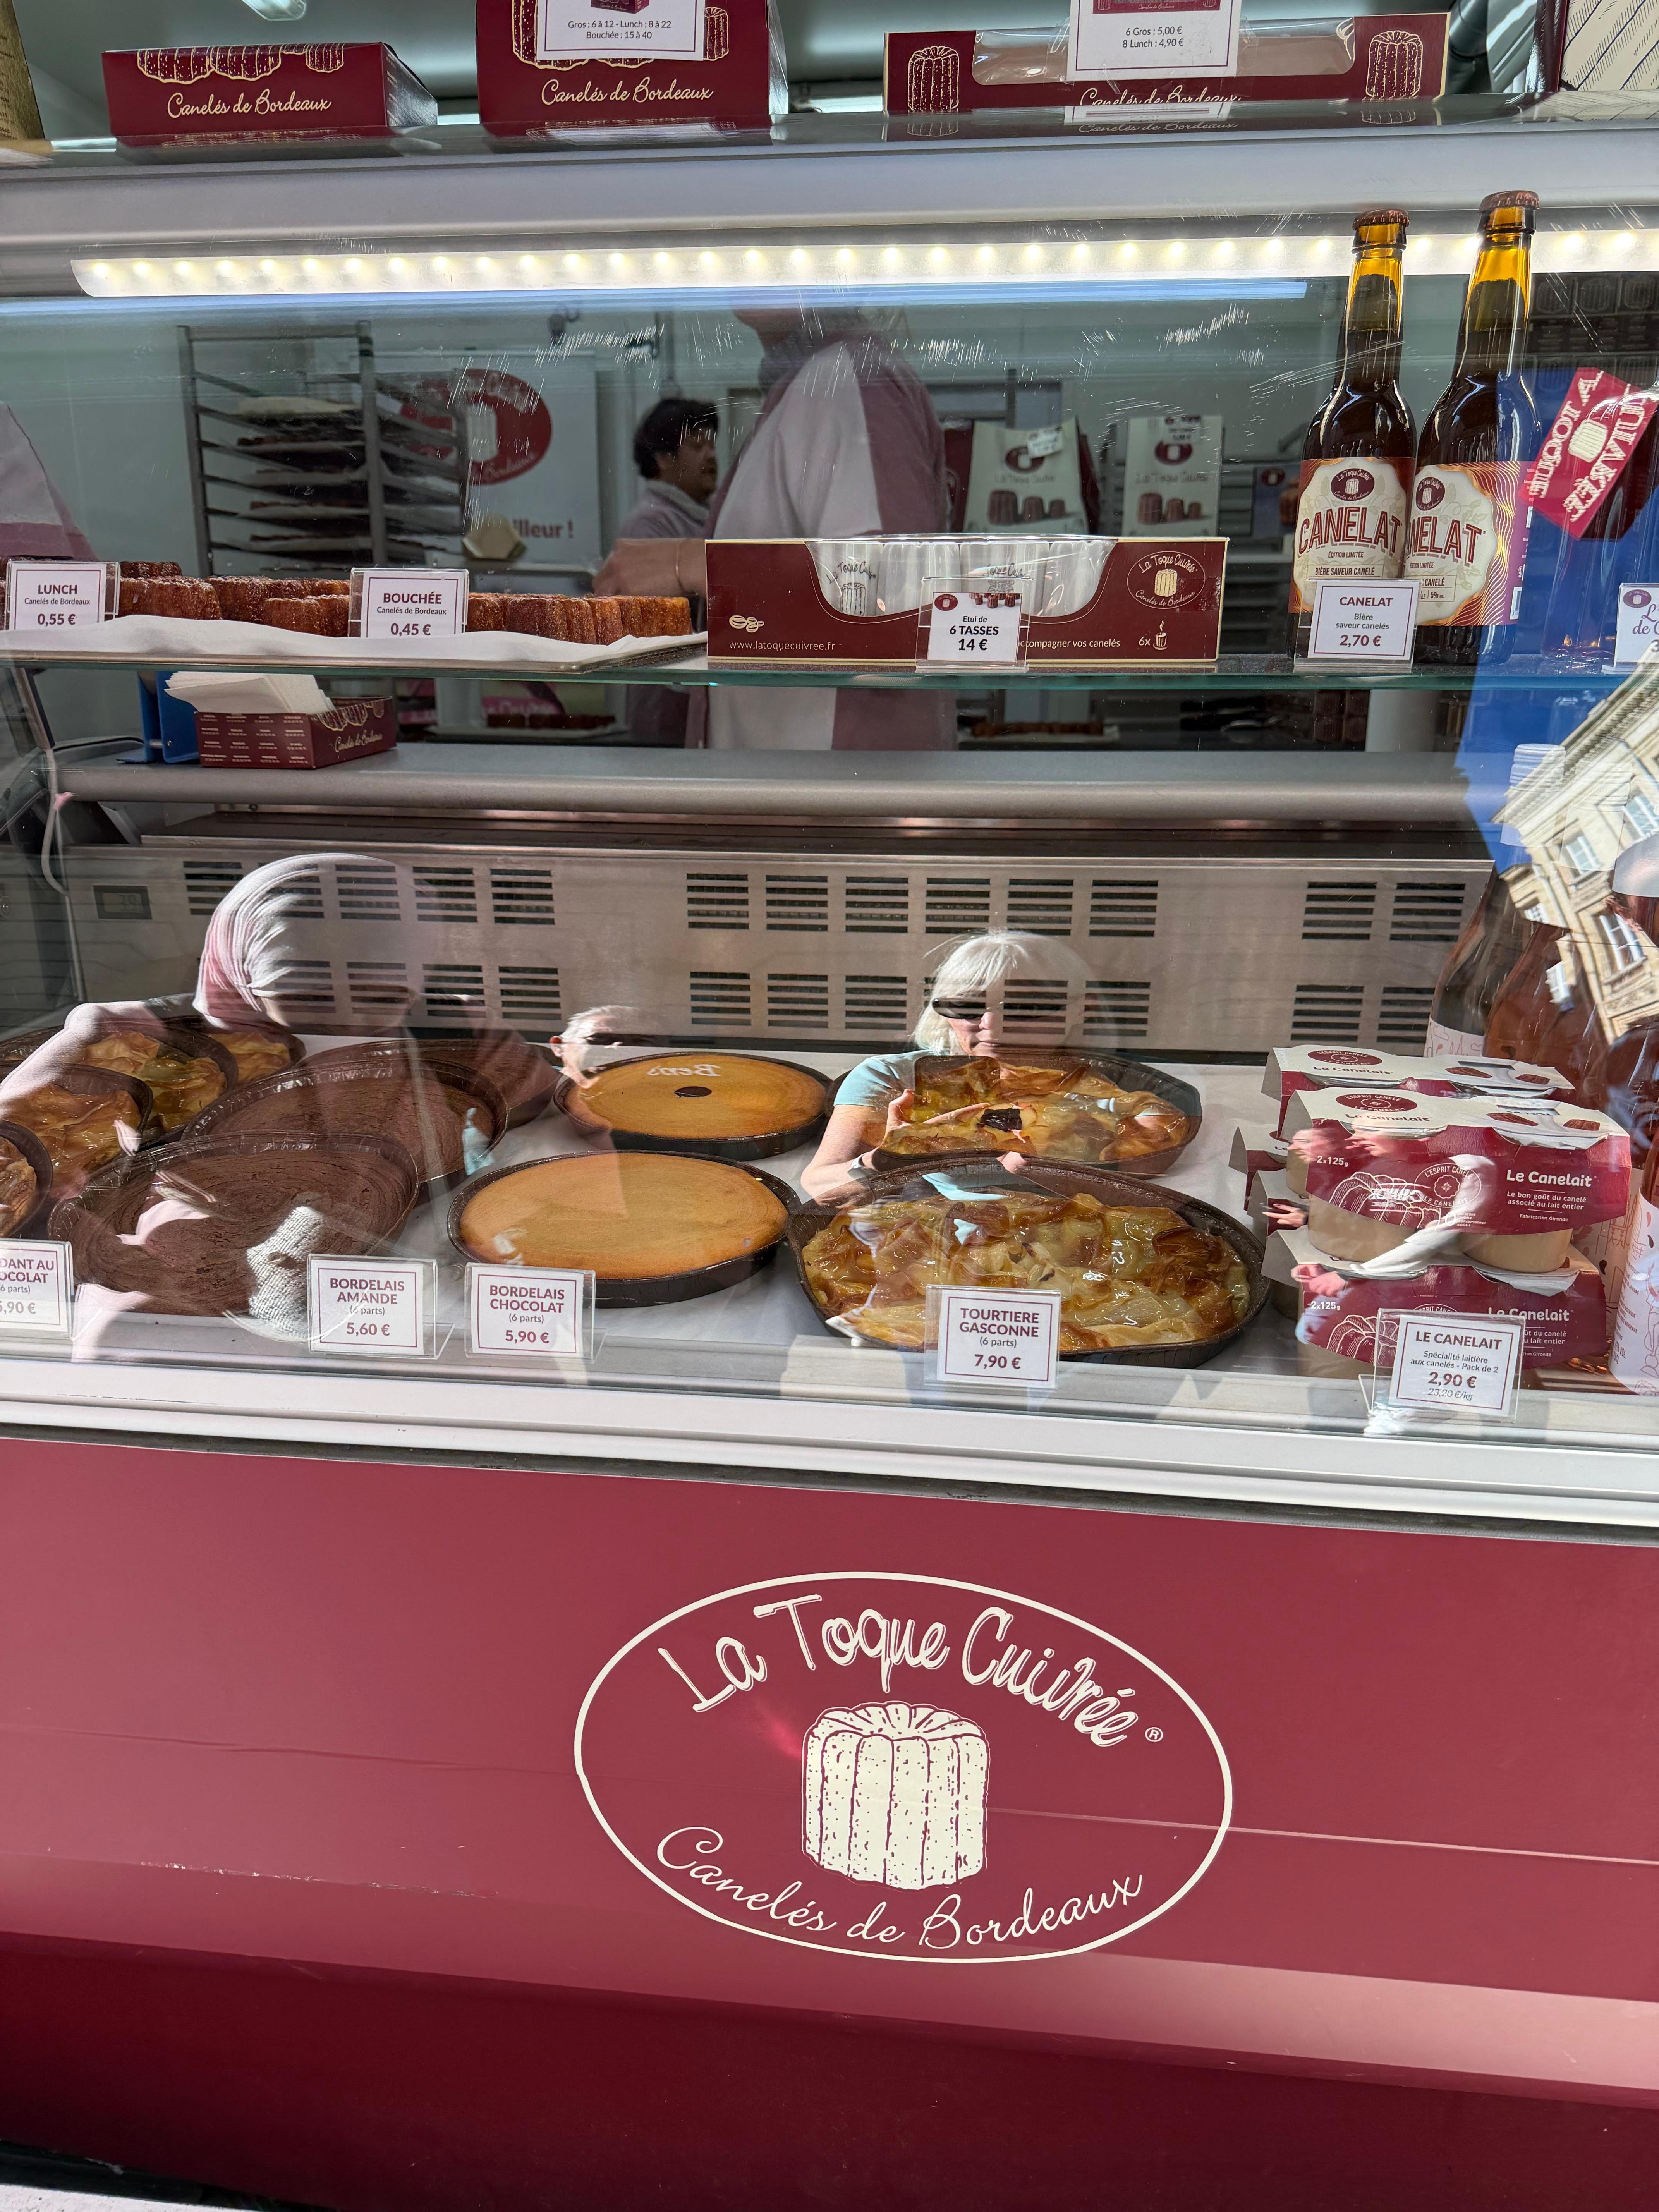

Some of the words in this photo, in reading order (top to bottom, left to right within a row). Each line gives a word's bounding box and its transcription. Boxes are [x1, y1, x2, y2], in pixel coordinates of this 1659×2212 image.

[1133, 27, 1151, 36] Gros
[1158, 27, 1175, 36] 5,00
[1177, 26, 1182, 34] €
[1130, 40, 1152, 48] Lunch
[1159, 38, 1176, 48] 4,90
[1178, 38, 1184, 46] €
[541, 79, 608, 105] Canelés
[609, 79, 630, 101] de
[632, 77, 714, 103] Bordeaux
[167, 92, 230, 118] Canelés
[233, 93, 252, 112] de
[254, 89, 331, 115] Bordeaux
[1298, 507, 1401, 554] CANELAT
[1408, 516, 1482, 563] NELAT
[1315, 566, 1329, 575] BIÈRE
[1331, 567, 1352, 575] SAVEUR
[1354, 567, 1374, 575] CANELÉ
[1425, 577, 1445, 586] CANELÉ
[38, 584, 77, 594] LUNCH
[383, 591, 442, 605] BOUCHÉE
[1340, 597, 1393, 607] CANELAT
[377, 606, 402, 614] Canelés
[415, 607, 447, 615] Bordeaux
[37, 613, 64, 627] 0,55
[68, 614, 76, 625] €
[390, 623, 419, 637] 0,45
[422, 624, 431, 635] €
[950, 626, 956, 634] 6
[959, 625, 999, 635] TASSES
[1632, 620, 1650, 634] de
[729, 641, 835, 651] www.latoquecuivree.fr
[958, 639, 975, 651] 14
[979, 639, 988, 651] €
[1089, 639, 1120, 647] canelés
[1139, 637, 1151, 646] 6x
[1340, 635, 1369, 647] 2,70
[1373, 635, 1382, 646] €
[1424, 1166, 1450, 1178] L'ESPRIT
[1506, 1169, 1525, 1182] Le
[1528, 1171, 1592, 1187] Canelait
[0, 1258, 34, 1269] DANT
[37, 1260, 54, 1271] AU
[0, 1271, 48, 1284] OCOLAT
[8, 1285, 31, 1294] parts)
[330, 1278, 405, 1291] BORDELAIS
[337, 1292, 398, 1304] AMANDE
[489, 1285, 565, 1300] BORDELAIS
[27, 1302, 36, 1314] €
[349, 1306, 358, 1315] (6
[361, 1307, 385, 1316] parts)
[490, 1299, 564, 1313] CHOCOLAT
[508, 1314, 517, 1322] (6
[520, 1314, 544, 1324] parts)
[960, 1307, 1039, 1323] TOURTIERE
[346, 1322, 378, 1337] 5,60
[381, 1324, 390, 1336] €
[959, 1322, 1039, 1337] GASCONNE
[505, 1330, 536, 1344] 5,90
[541, 1332, 549, 1344] €
[980, 1336, 988, 1346] (6
[991, 1338, 1017, 1348] parts)
[1415, 1331, 1431, 1342] LE
[1434, 1333, 1502, 1350] CANELAIT
[974, 1353, 1007, 1369] 7,90
[1012, 1357, 1021, 1369] €
[1424, 1351, 1460, 1360] Spécialité
[1462, 1355, 1488, 1364] laitière
[1462, 1363, 1480, 1372] Pack
[1427, 1372, 1463, 1387] 2,90
[1467, 1376, 1477, 1388] €
[1428, 1388, 1453, 1397] 23,20
[1455, 1391, 1473, 1401] €/kg
[657, 1644, 768, 1714] La
[753, 1594, 950, 1693] Toque
[962, 1605, 1141, 1748] Cuivrée
[656, 1826, 838, 1933] Canelés
[847, 1902, 906, 1945] de
[919, 1874, 1143, 1950] Bordeaux
